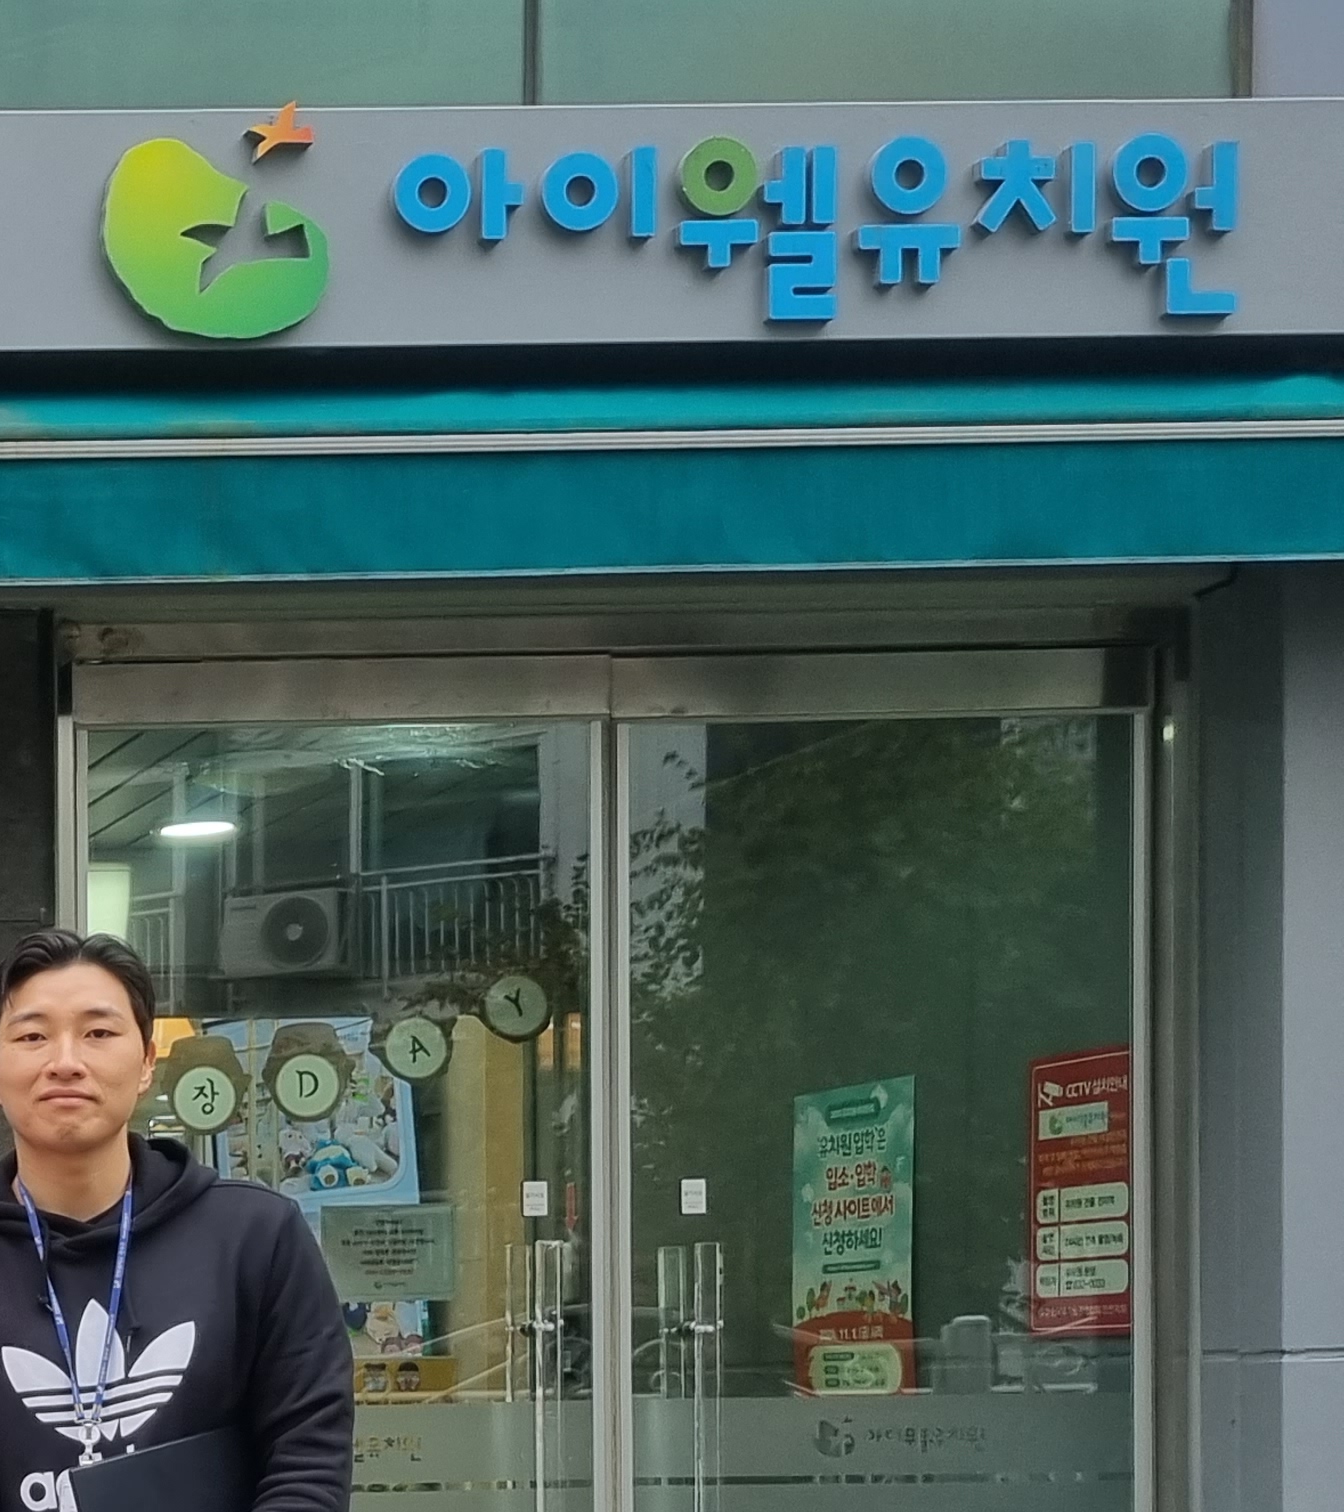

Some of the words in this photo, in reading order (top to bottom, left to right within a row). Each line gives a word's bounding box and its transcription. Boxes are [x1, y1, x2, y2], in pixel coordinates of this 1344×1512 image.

[393, 133, 1238, 321] 아이웰유치원
[1066, 1081, 1091, 1098] CCTV
[822, 1227, 882, 1255] 신청하세요!
